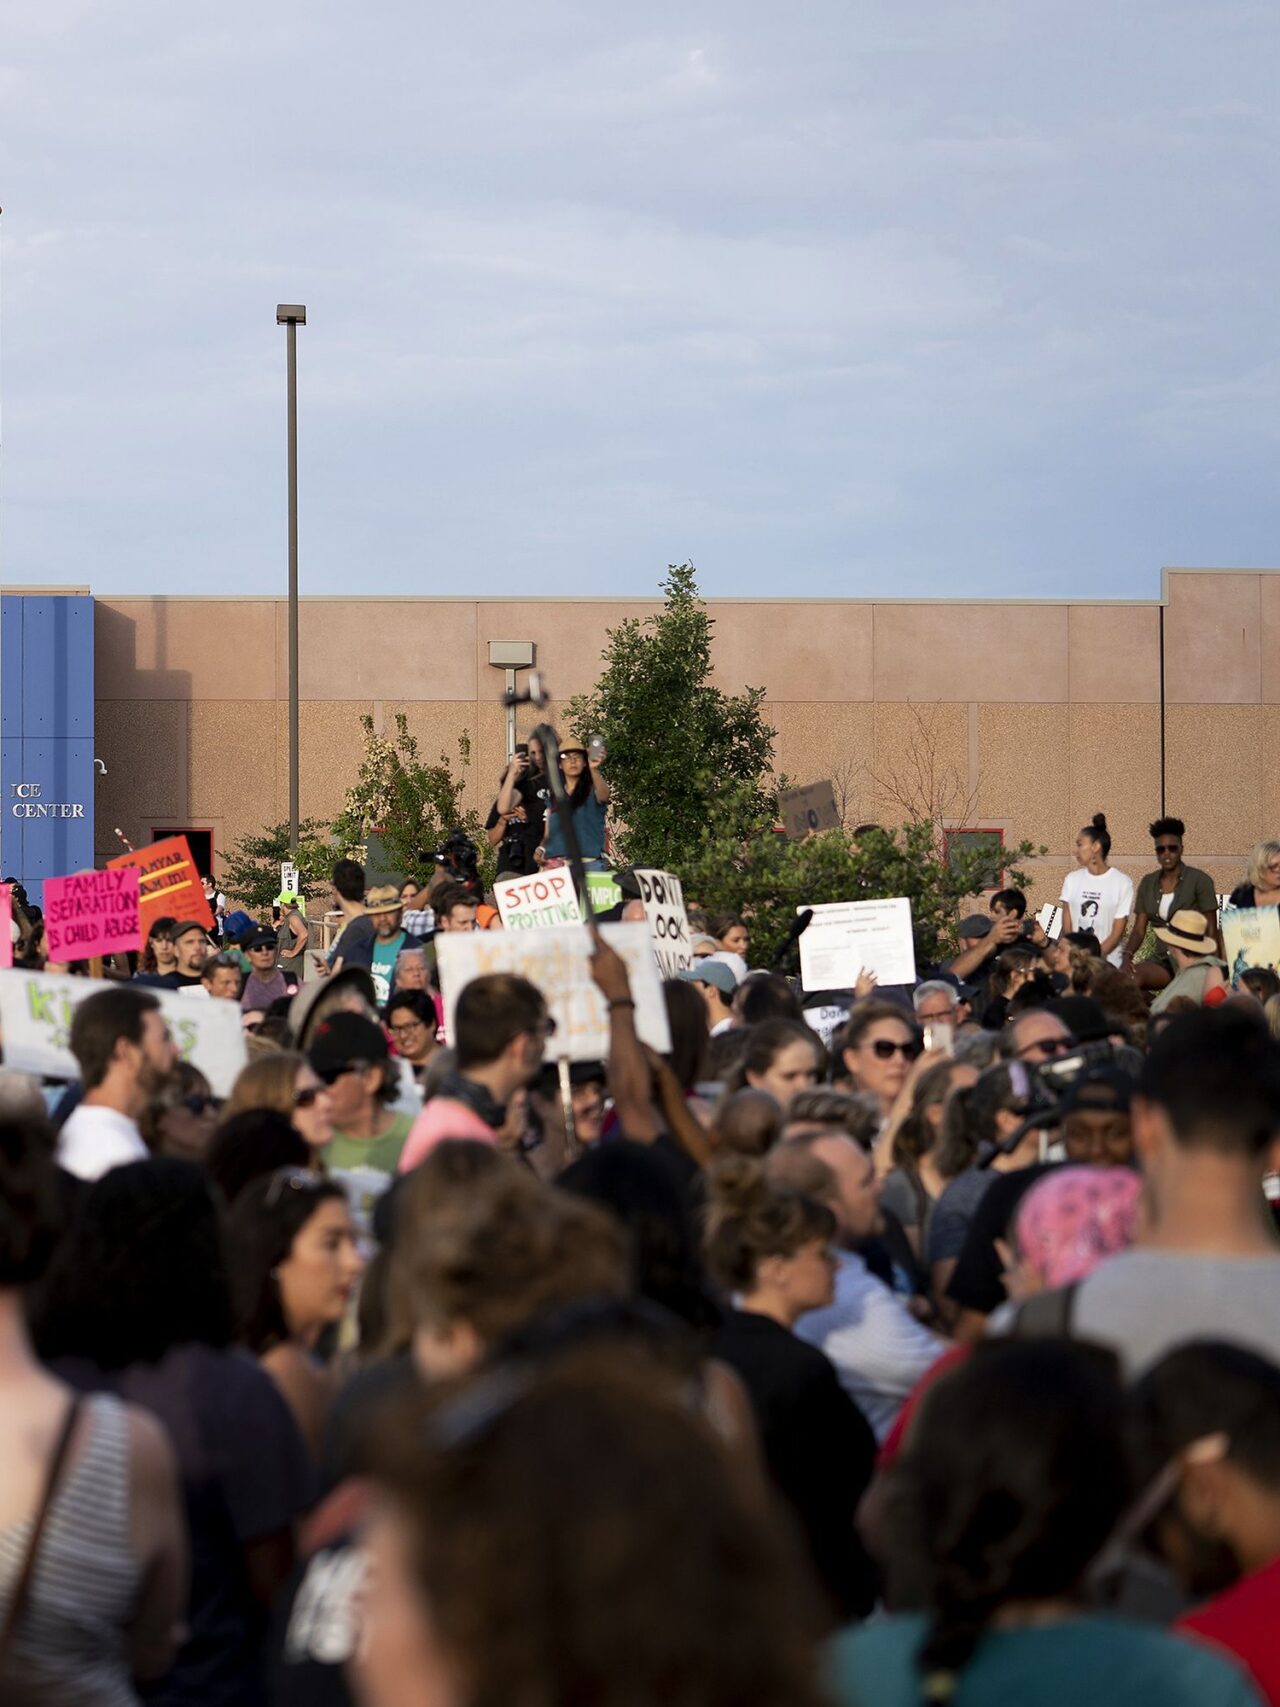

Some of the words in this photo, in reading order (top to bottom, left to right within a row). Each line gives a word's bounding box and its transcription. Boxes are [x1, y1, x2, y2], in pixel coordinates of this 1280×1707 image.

[10, 783, 41, 798] ICE
[12, 803, 85, 818] CENTER
[63, 872, 126, 898] FAMILY
[287, 879, 293, 891] 5
[505, 877, 565, 909] STOP
[50, 891, 139, 924] SEPARATION
[507, 901, 578, 929] PROFITING
[47, 929, 60, 951] IS
[64, 921, 100, 944] CHILD
[104, 914, 140, 939] ABUSE
